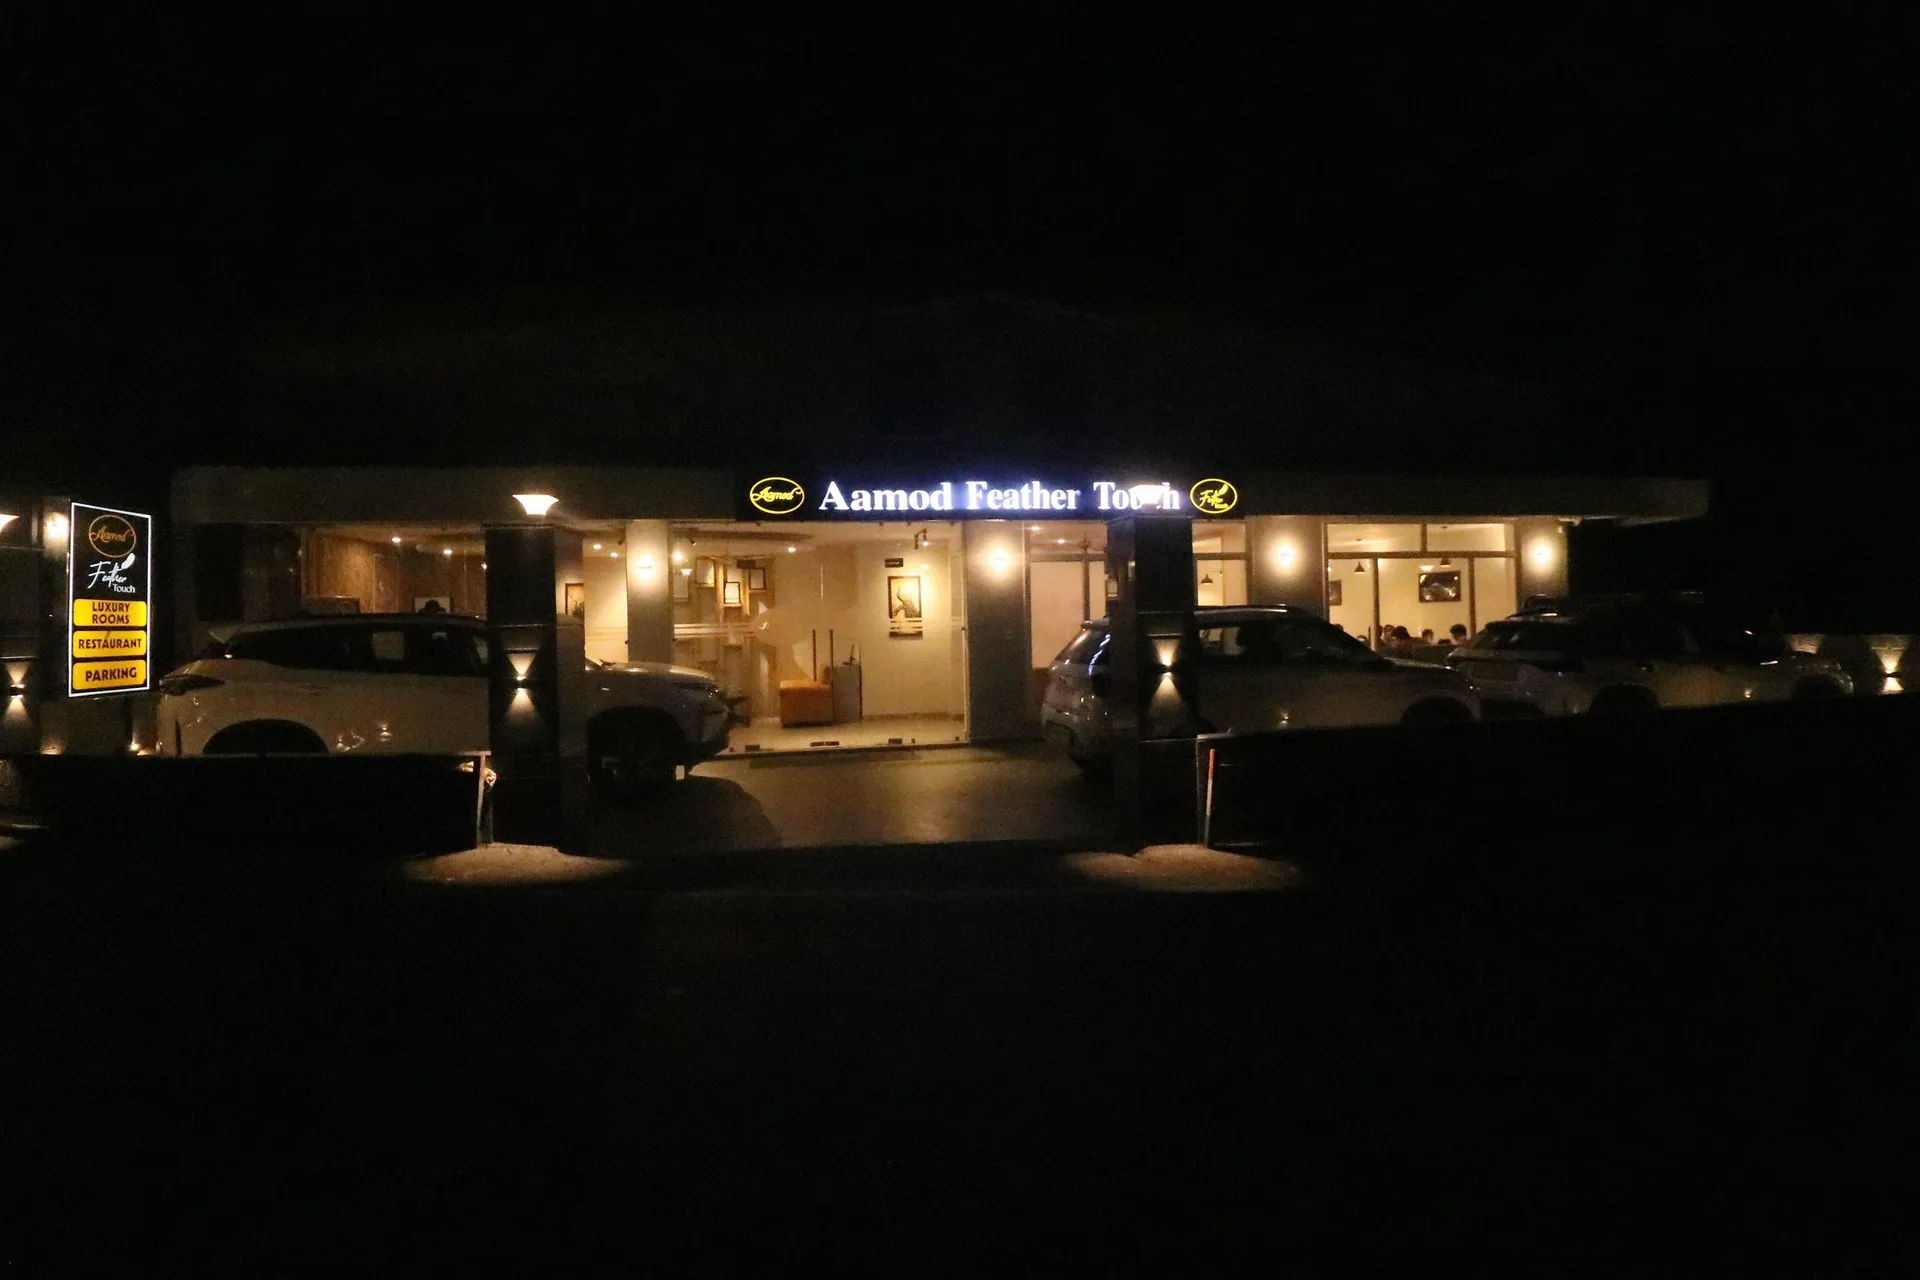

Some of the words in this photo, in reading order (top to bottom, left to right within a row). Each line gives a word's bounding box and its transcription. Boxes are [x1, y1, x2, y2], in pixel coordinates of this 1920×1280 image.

[818, 480, 953, 511] Aamod
[965, 480, 1081, 510] Feather
[1092, 481, 1180, 510] Touh
[112, 583, 136, 594] Touch
[92, 602, 130, 613] LUXURY
[92, 614, 130, 625] ROOMS
[78, 638, 142, 650] RESTAURANT
[85, 667, 137, 682] PARKING
